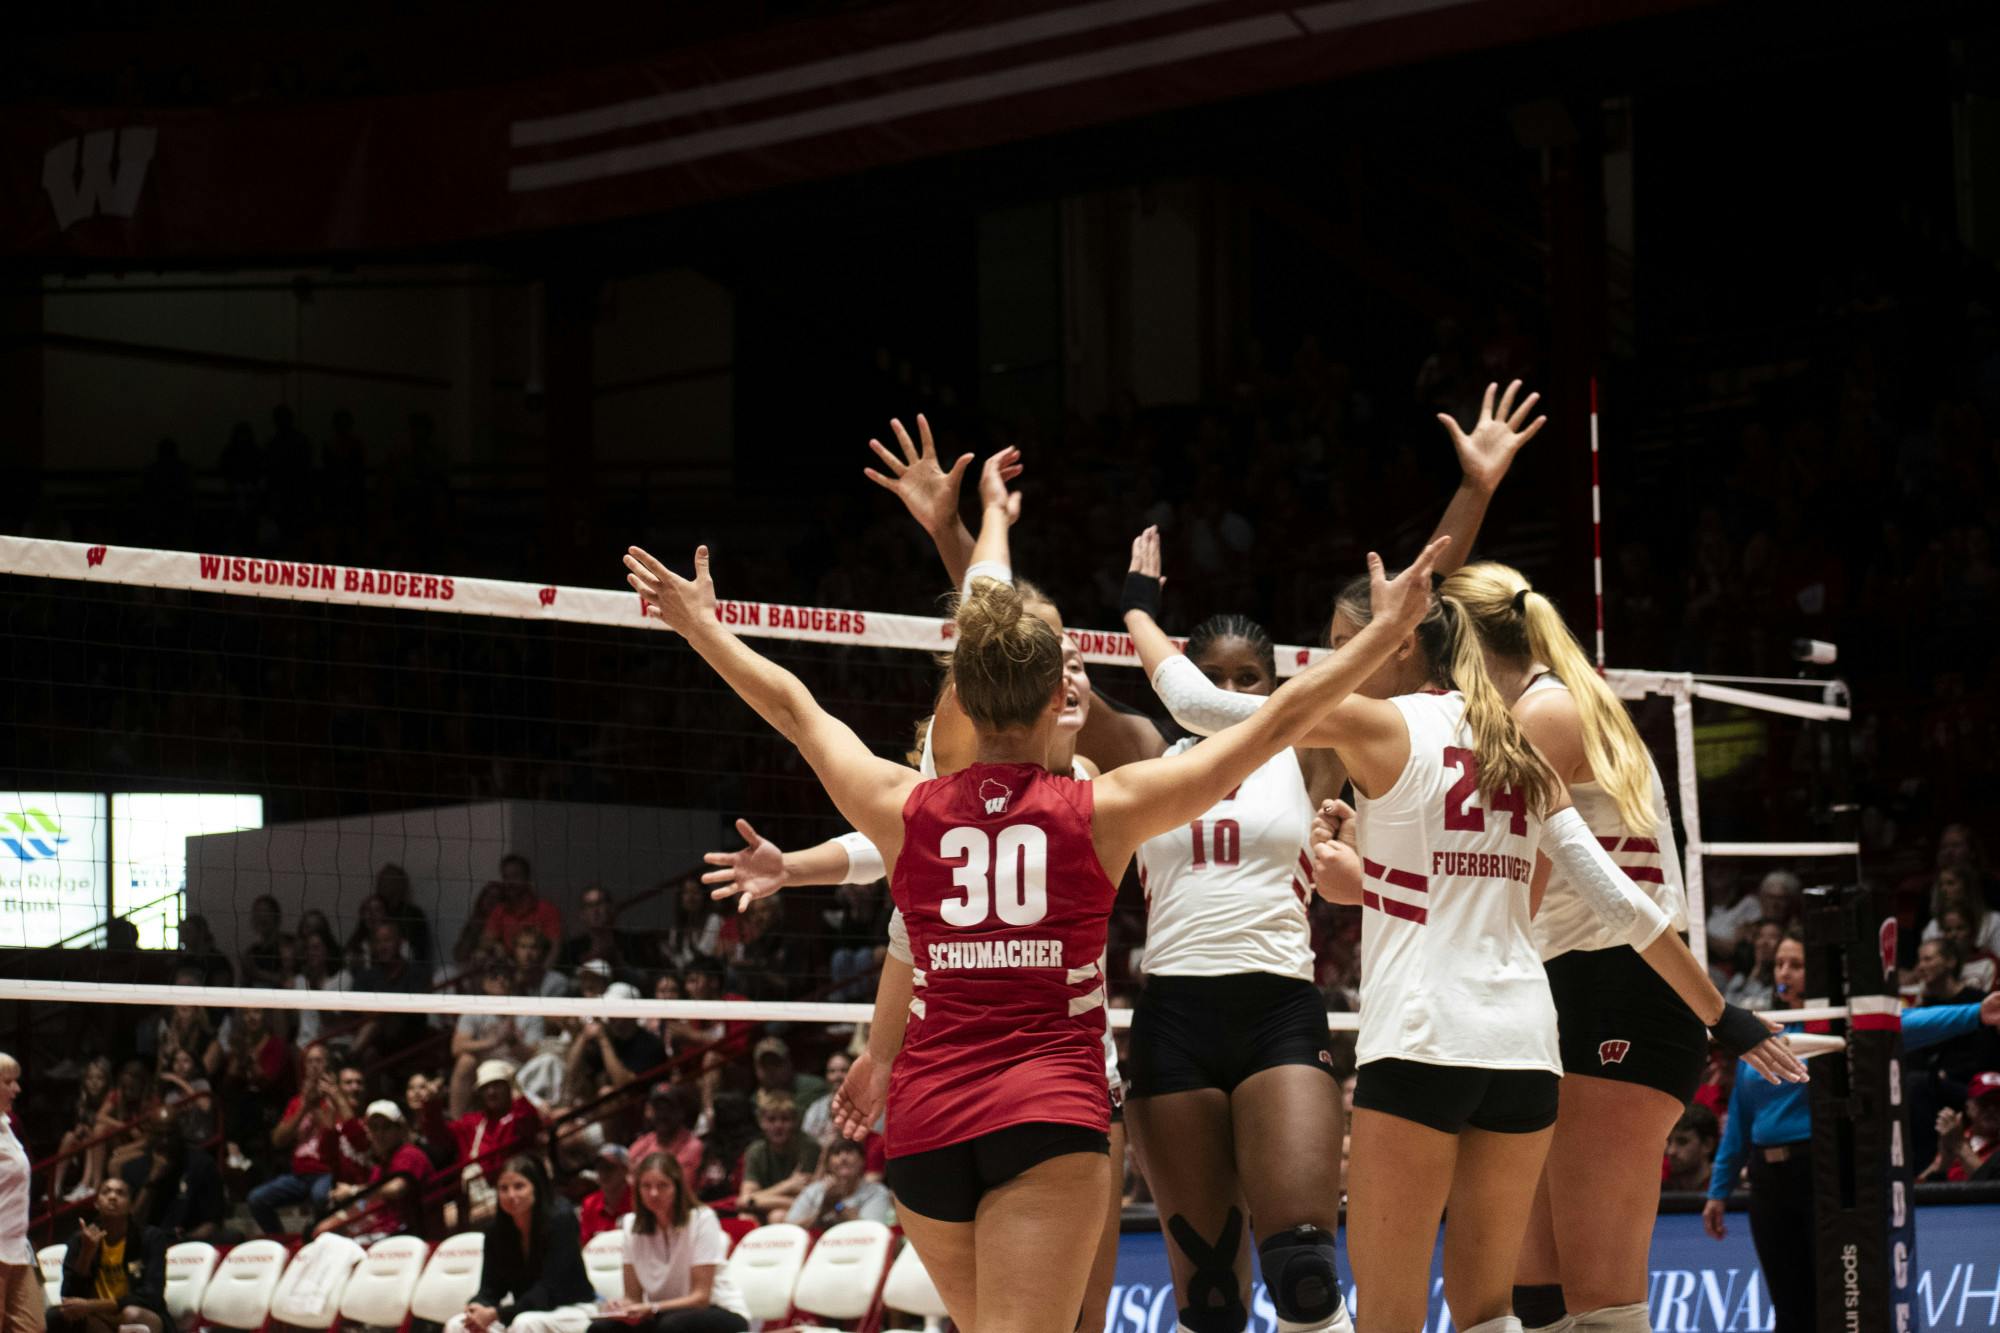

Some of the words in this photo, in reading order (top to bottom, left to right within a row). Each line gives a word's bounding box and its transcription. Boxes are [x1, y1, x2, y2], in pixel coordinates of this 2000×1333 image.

[41, 125, 160, 232] W
[200, 553, 336, 590] WISCONSIN
[344, 568, 455, 600] BADGERS
[768, 606, 865, 635] BADGERS
[1443, 746, 1529, 837] 24
[1190, 819, 1240, 870] 10
[28, 874, 90, 893] Ridge
[940, 824, 1047, 927] 30
[4, 896, 56, 913] Bank
[928, 940, 1063, 970] SCHUMACHER
[1598, 1040, 1631, 1066] W
[1841, 1244, 1860, 1308] sports
